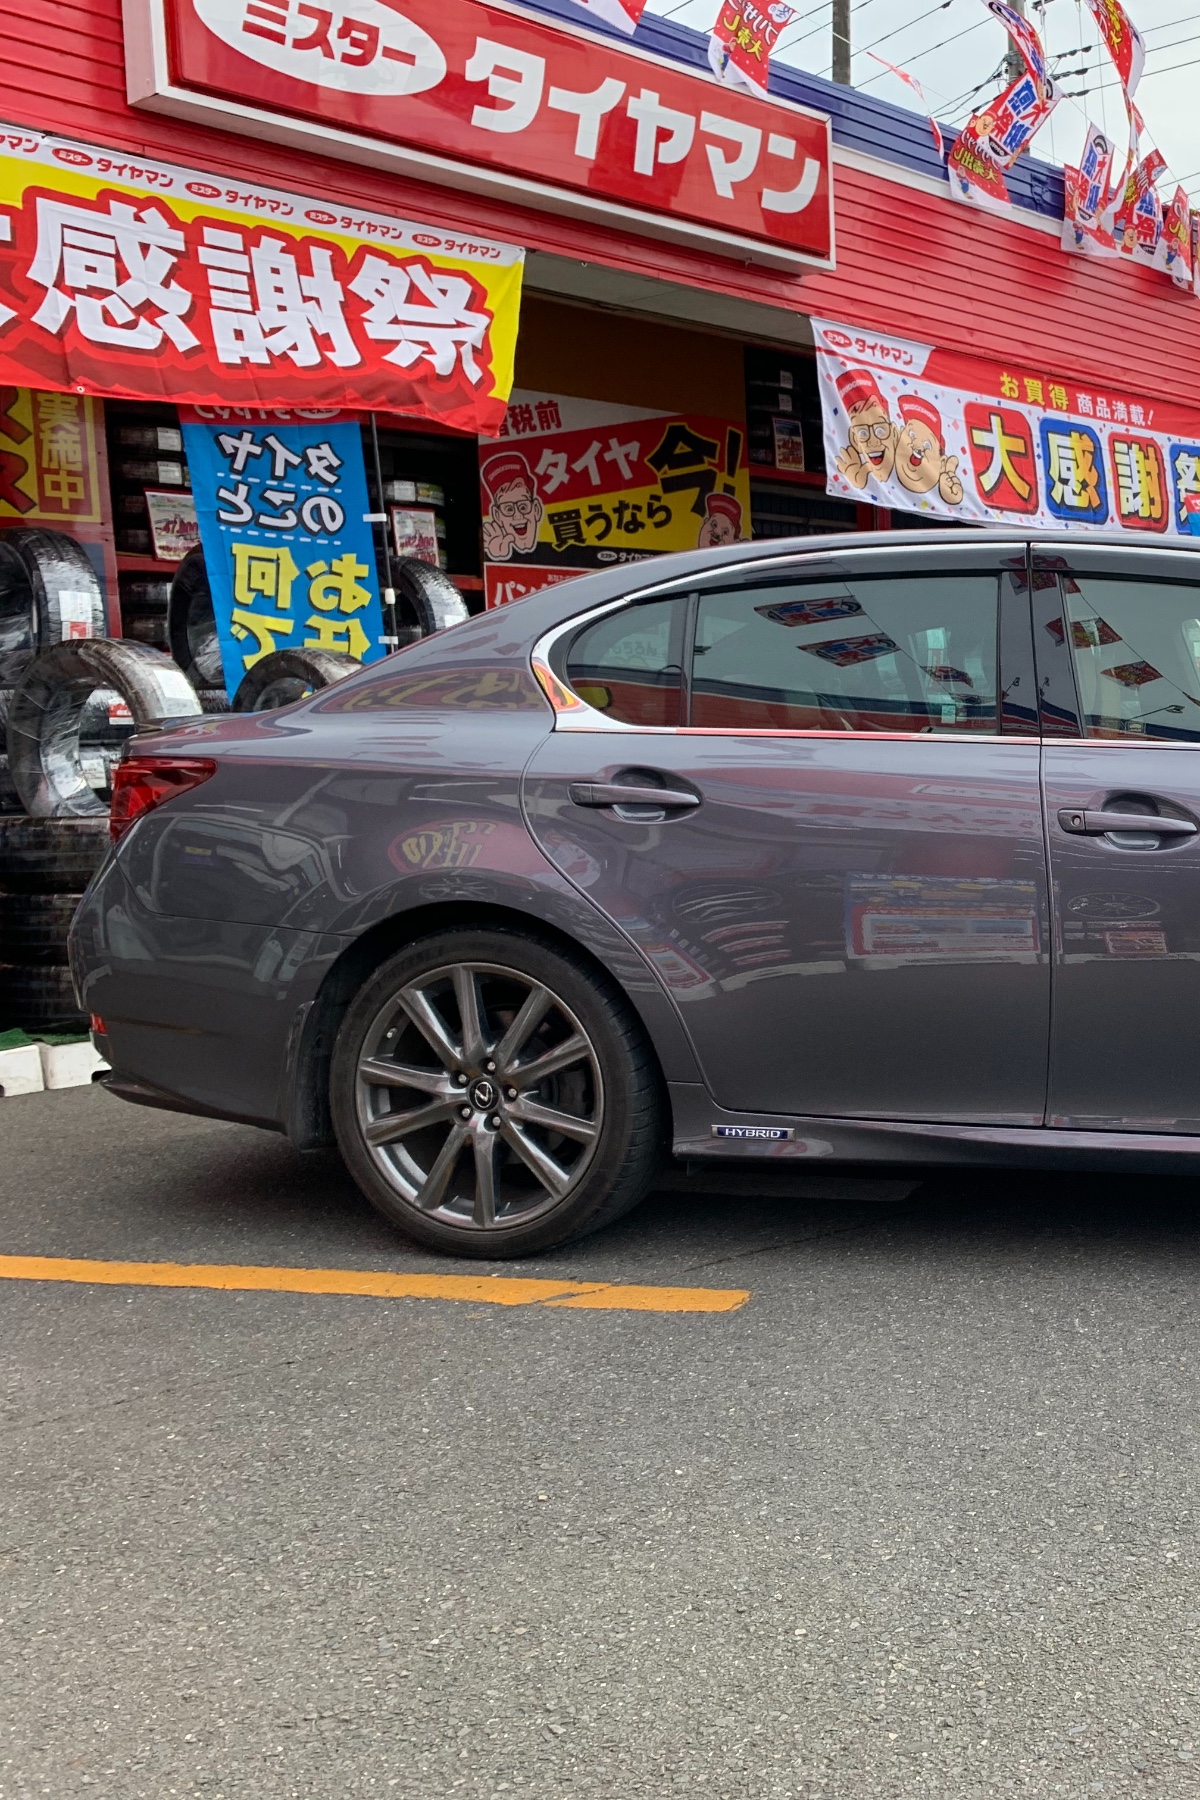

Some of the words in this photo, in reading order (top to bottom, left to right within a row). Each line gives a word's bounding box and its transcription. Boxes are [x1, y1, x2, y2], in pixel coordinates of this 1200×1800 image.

[242, 0, 416, 67] ミスター
[465, 36, 821, 214] タイヤマン
[97, 158, 174, 187] タイヤマン
[225, 190, 294, 216] タイヤマン
[340, 216, 403, 240] タイヤマン
[444, 239, 501, 259] タイヤマン
[0, 197, 491, 385] 感謝祭
[855, 338, 913, 366] タイヤマン
[1000, 372, 1069, 411] お買得
[1076, 393, 1154, 426] 商品満載!
[534, 438, 641, 495] タイヤ
[547, 494, 673, 550] 買うなら
[725, 1127, 781, 1138] HYBRID
